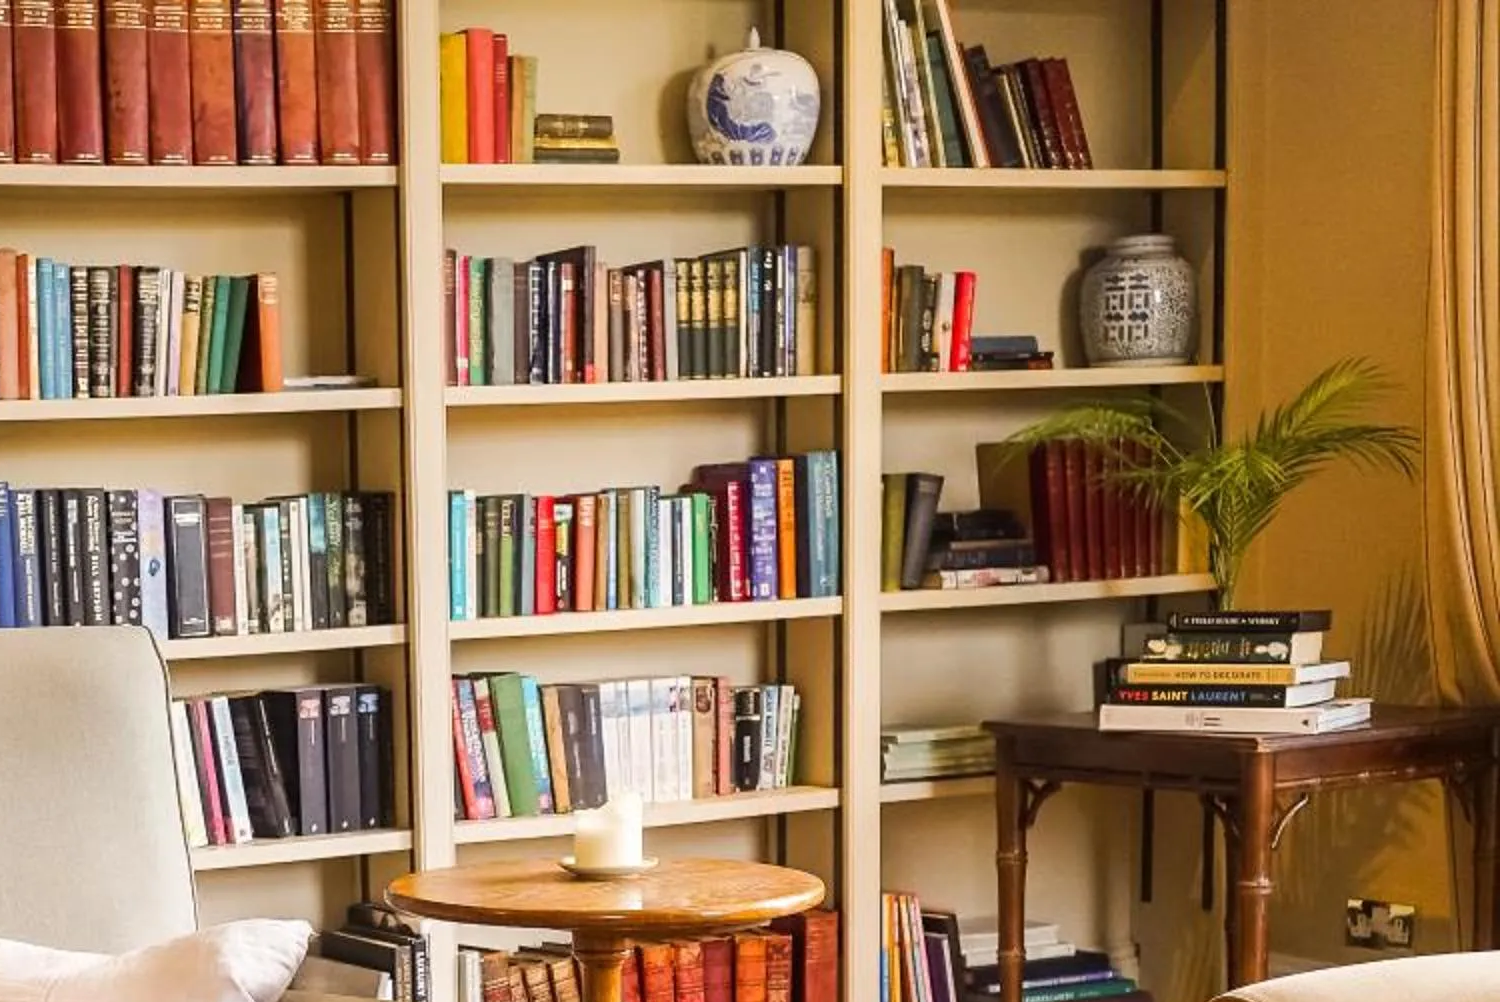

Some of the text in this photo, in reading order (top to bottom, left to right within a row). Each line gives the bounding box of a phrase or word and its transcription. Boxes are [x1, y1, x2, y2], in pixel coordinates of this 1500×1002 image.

[1200, 671, 1211, 680] TO
[1118, 690, 1247, 701] YVES SAINT LAURENT
